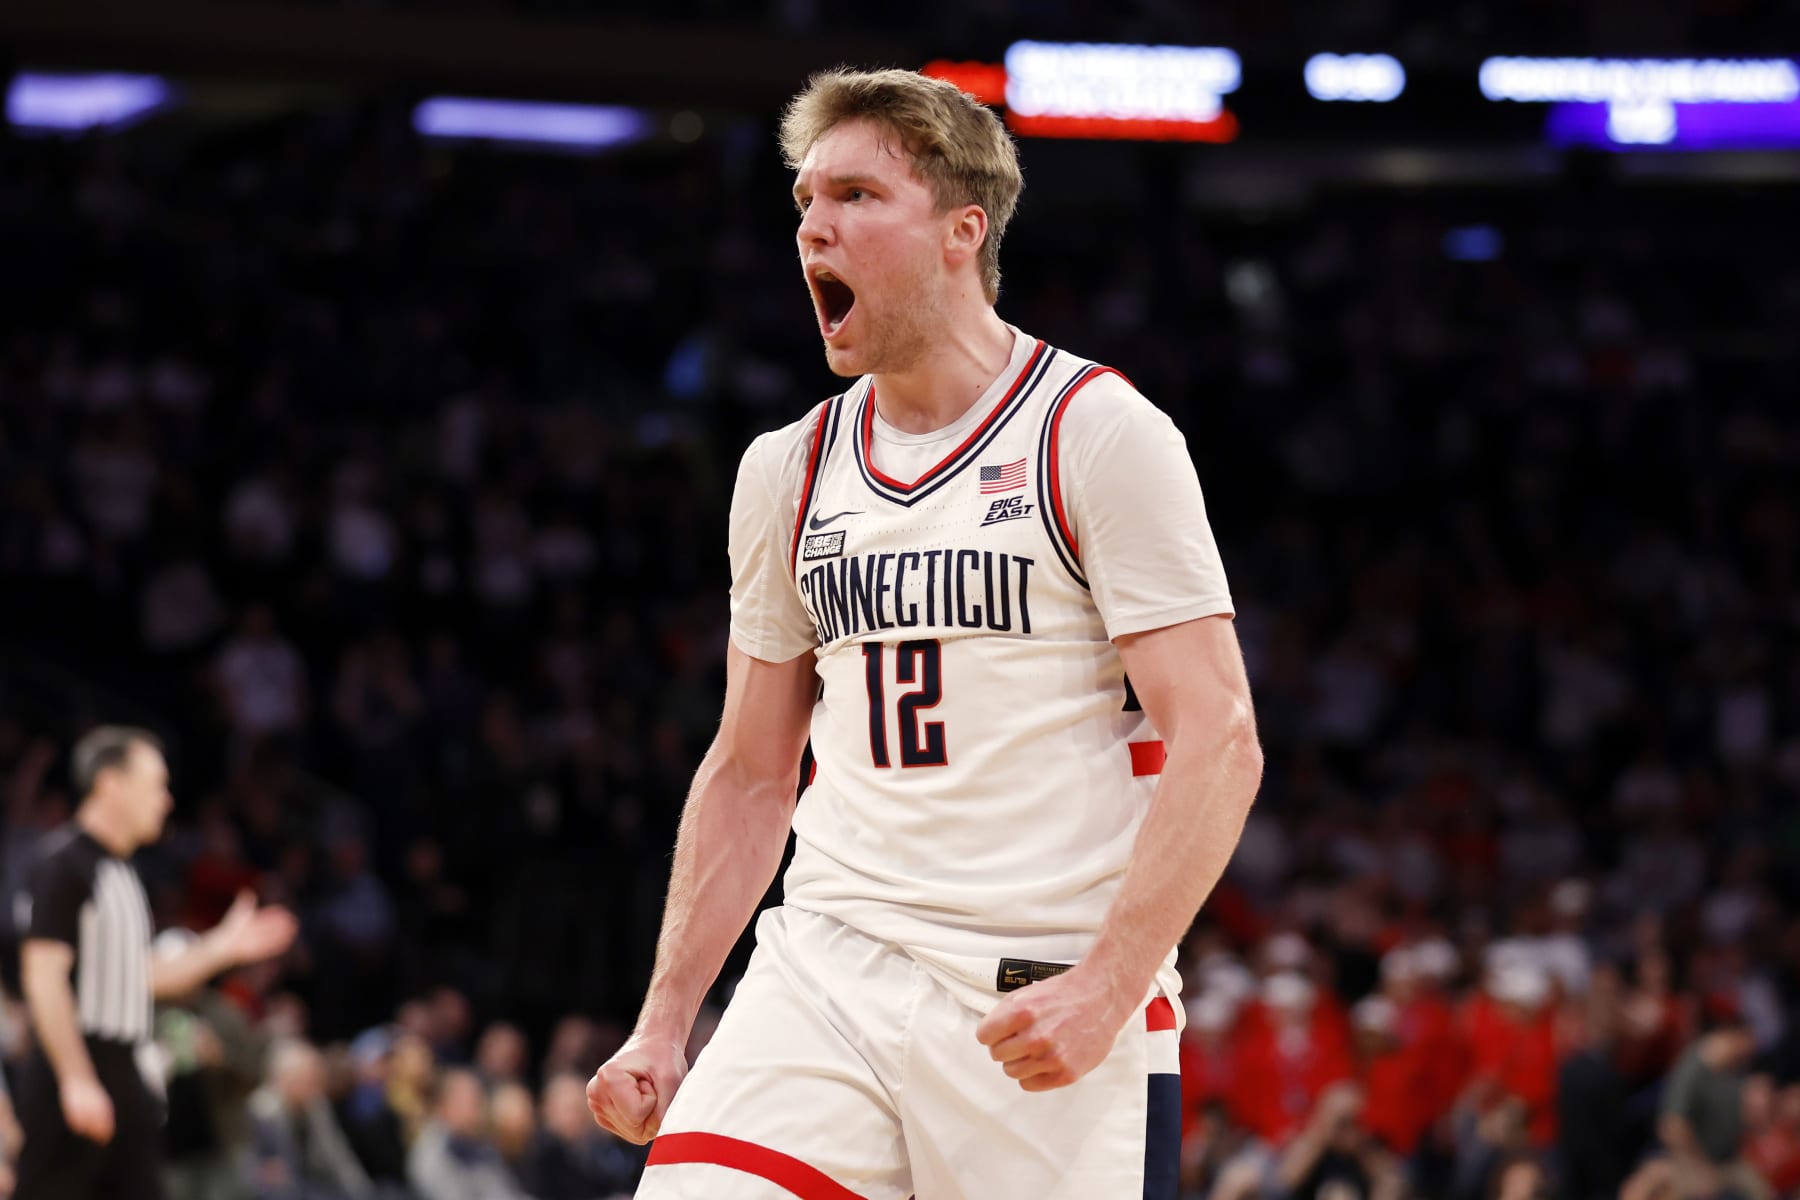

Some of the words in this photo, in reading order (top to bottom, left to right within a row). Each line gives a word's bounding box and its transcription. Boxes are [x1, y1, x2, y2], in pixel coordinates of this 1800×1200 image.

[989, 495, 1024, 511] BIG
[984, 505, 1035, 522] EAST
[804, 545, 842, 558] CHANGE
[861, 639, 948, 768] 12
